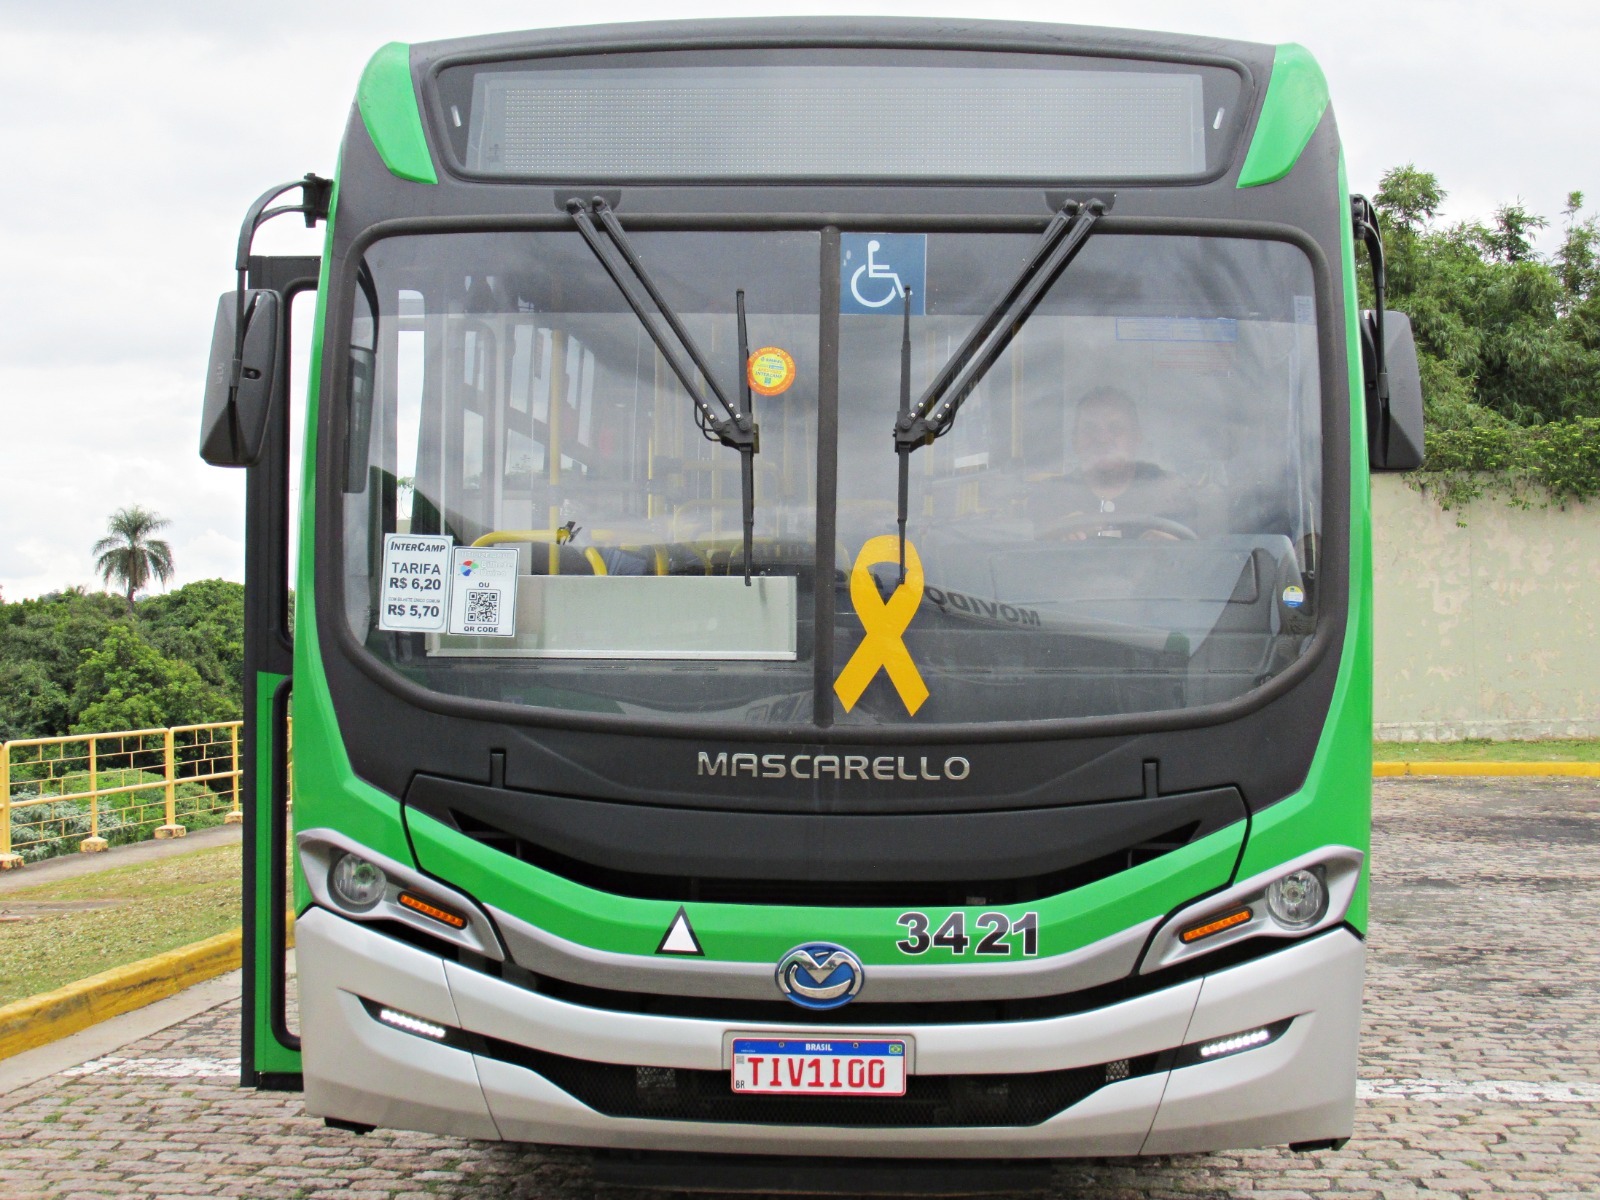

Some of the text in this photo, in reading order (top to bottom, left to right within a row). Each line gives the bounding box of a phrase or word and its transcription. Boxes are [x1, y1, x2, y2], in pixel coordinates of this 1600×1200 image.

[392, 562, 441, 575] TARIFA
[389, 577, 441, 592] R$ 6,20
[387, 604, 440, 619] R$ 5,70
[697, 751, 970, 781] MASCARELLO
[895, 911, 1038, 957] 3421
[805, 1043, 833, 1051] BRASIL
[747, 1057, 885, 1088] TIV1I00
[735, 1080, 745, 1089] BR
